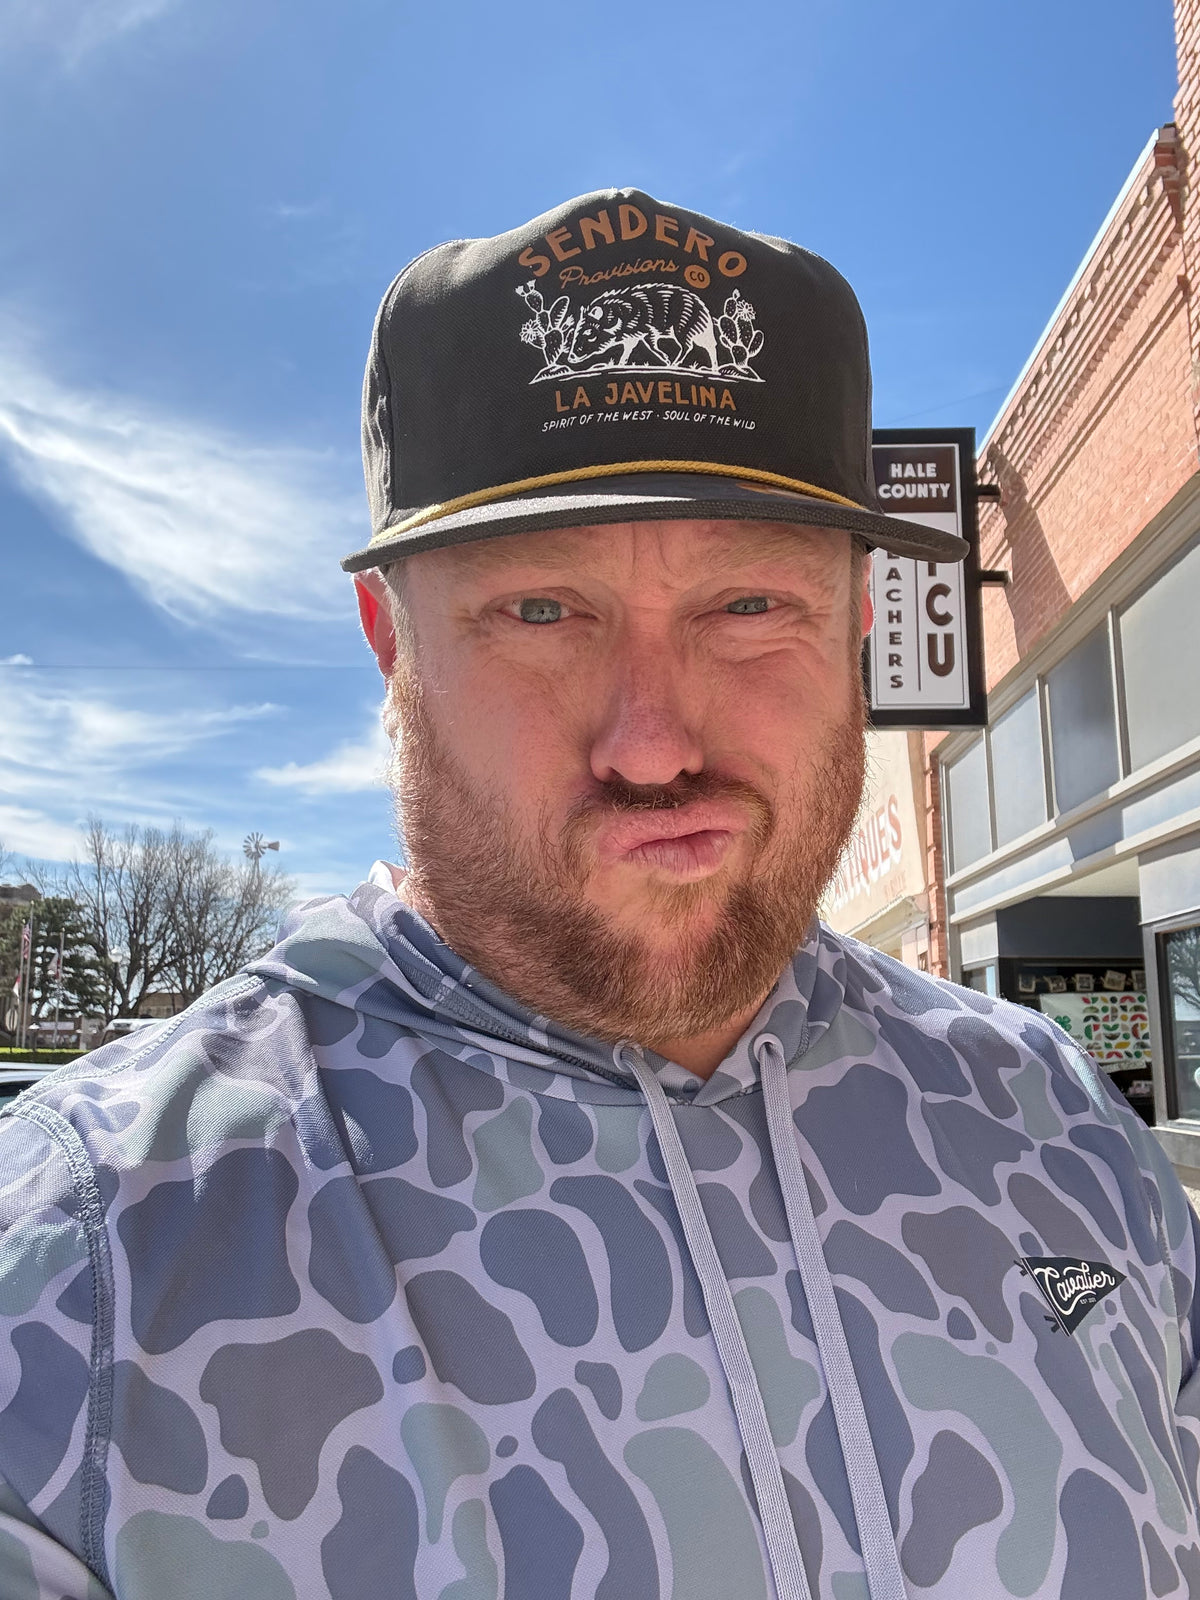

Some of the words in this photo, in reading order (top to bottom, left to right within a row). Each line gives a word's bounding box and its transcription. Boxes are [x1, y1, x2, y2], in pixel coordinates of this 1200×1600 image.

[517, 203, 748, 277] SENDERO
[559, 257, 679, 289] Provisions
[689, 269, 706, 283] CO
[555, 386, 591, 412] LA
[604, 381, 737, 411] JAVELINA
[541, 416, 576, 432] SPIRIT
[579, 413, 594, 425] OF
[597, 411, 619, 423] THE
[622, 410, 653, 421] WEST
[663, 410, 690, 421] SOUL
[693, 412, 706, 423] OF
[709, 415, 731, 426] THE
[733, 418, 756, 430] WILD
[890, 462, 937, 478] HALE
[878, 482, 951, 499] COUNTY
[1033, 1261, 1116, 1316] Cavalier
